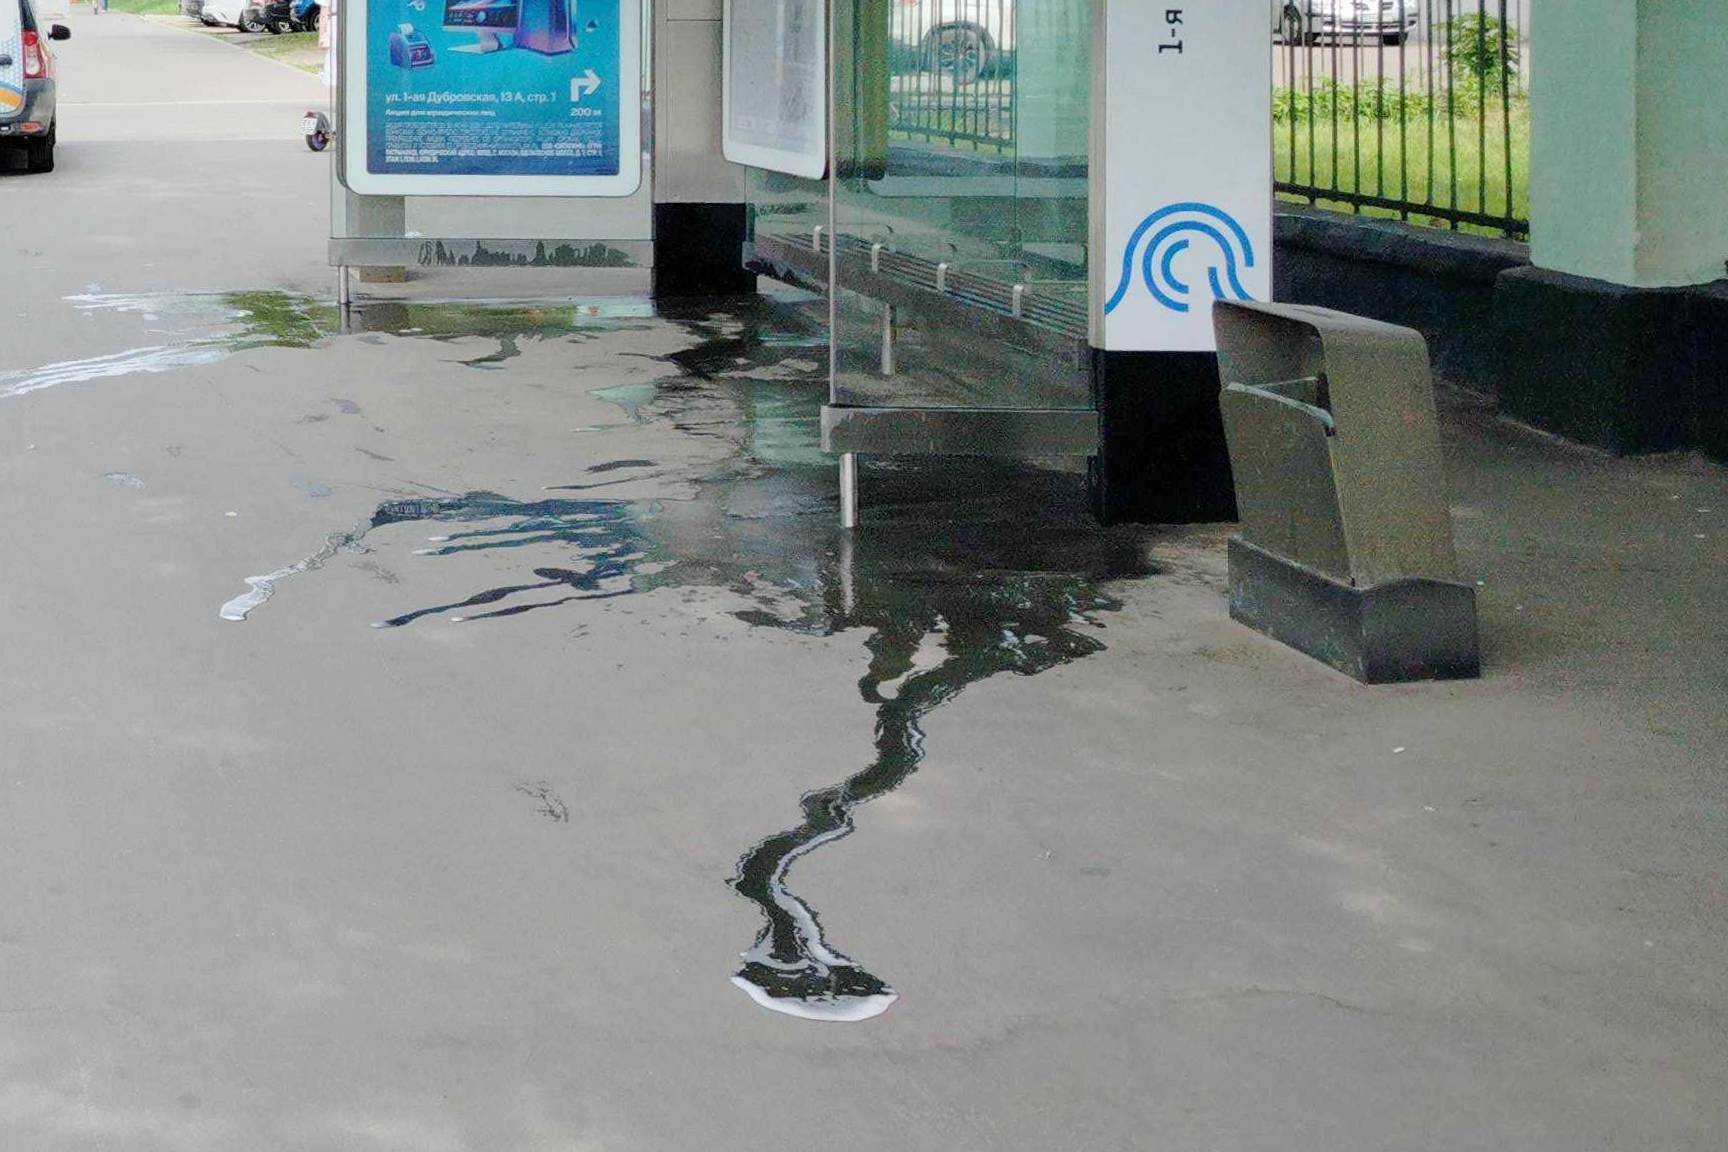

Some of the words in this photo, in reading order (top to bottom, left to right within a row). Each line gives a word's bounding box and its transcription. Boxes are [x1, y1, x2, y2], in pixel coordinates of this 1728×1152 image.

[1158, 9, 1184, 54] 1-я
[426, 91, 498, 104] Дубровская,
[570, 108, 592, 117] 200
